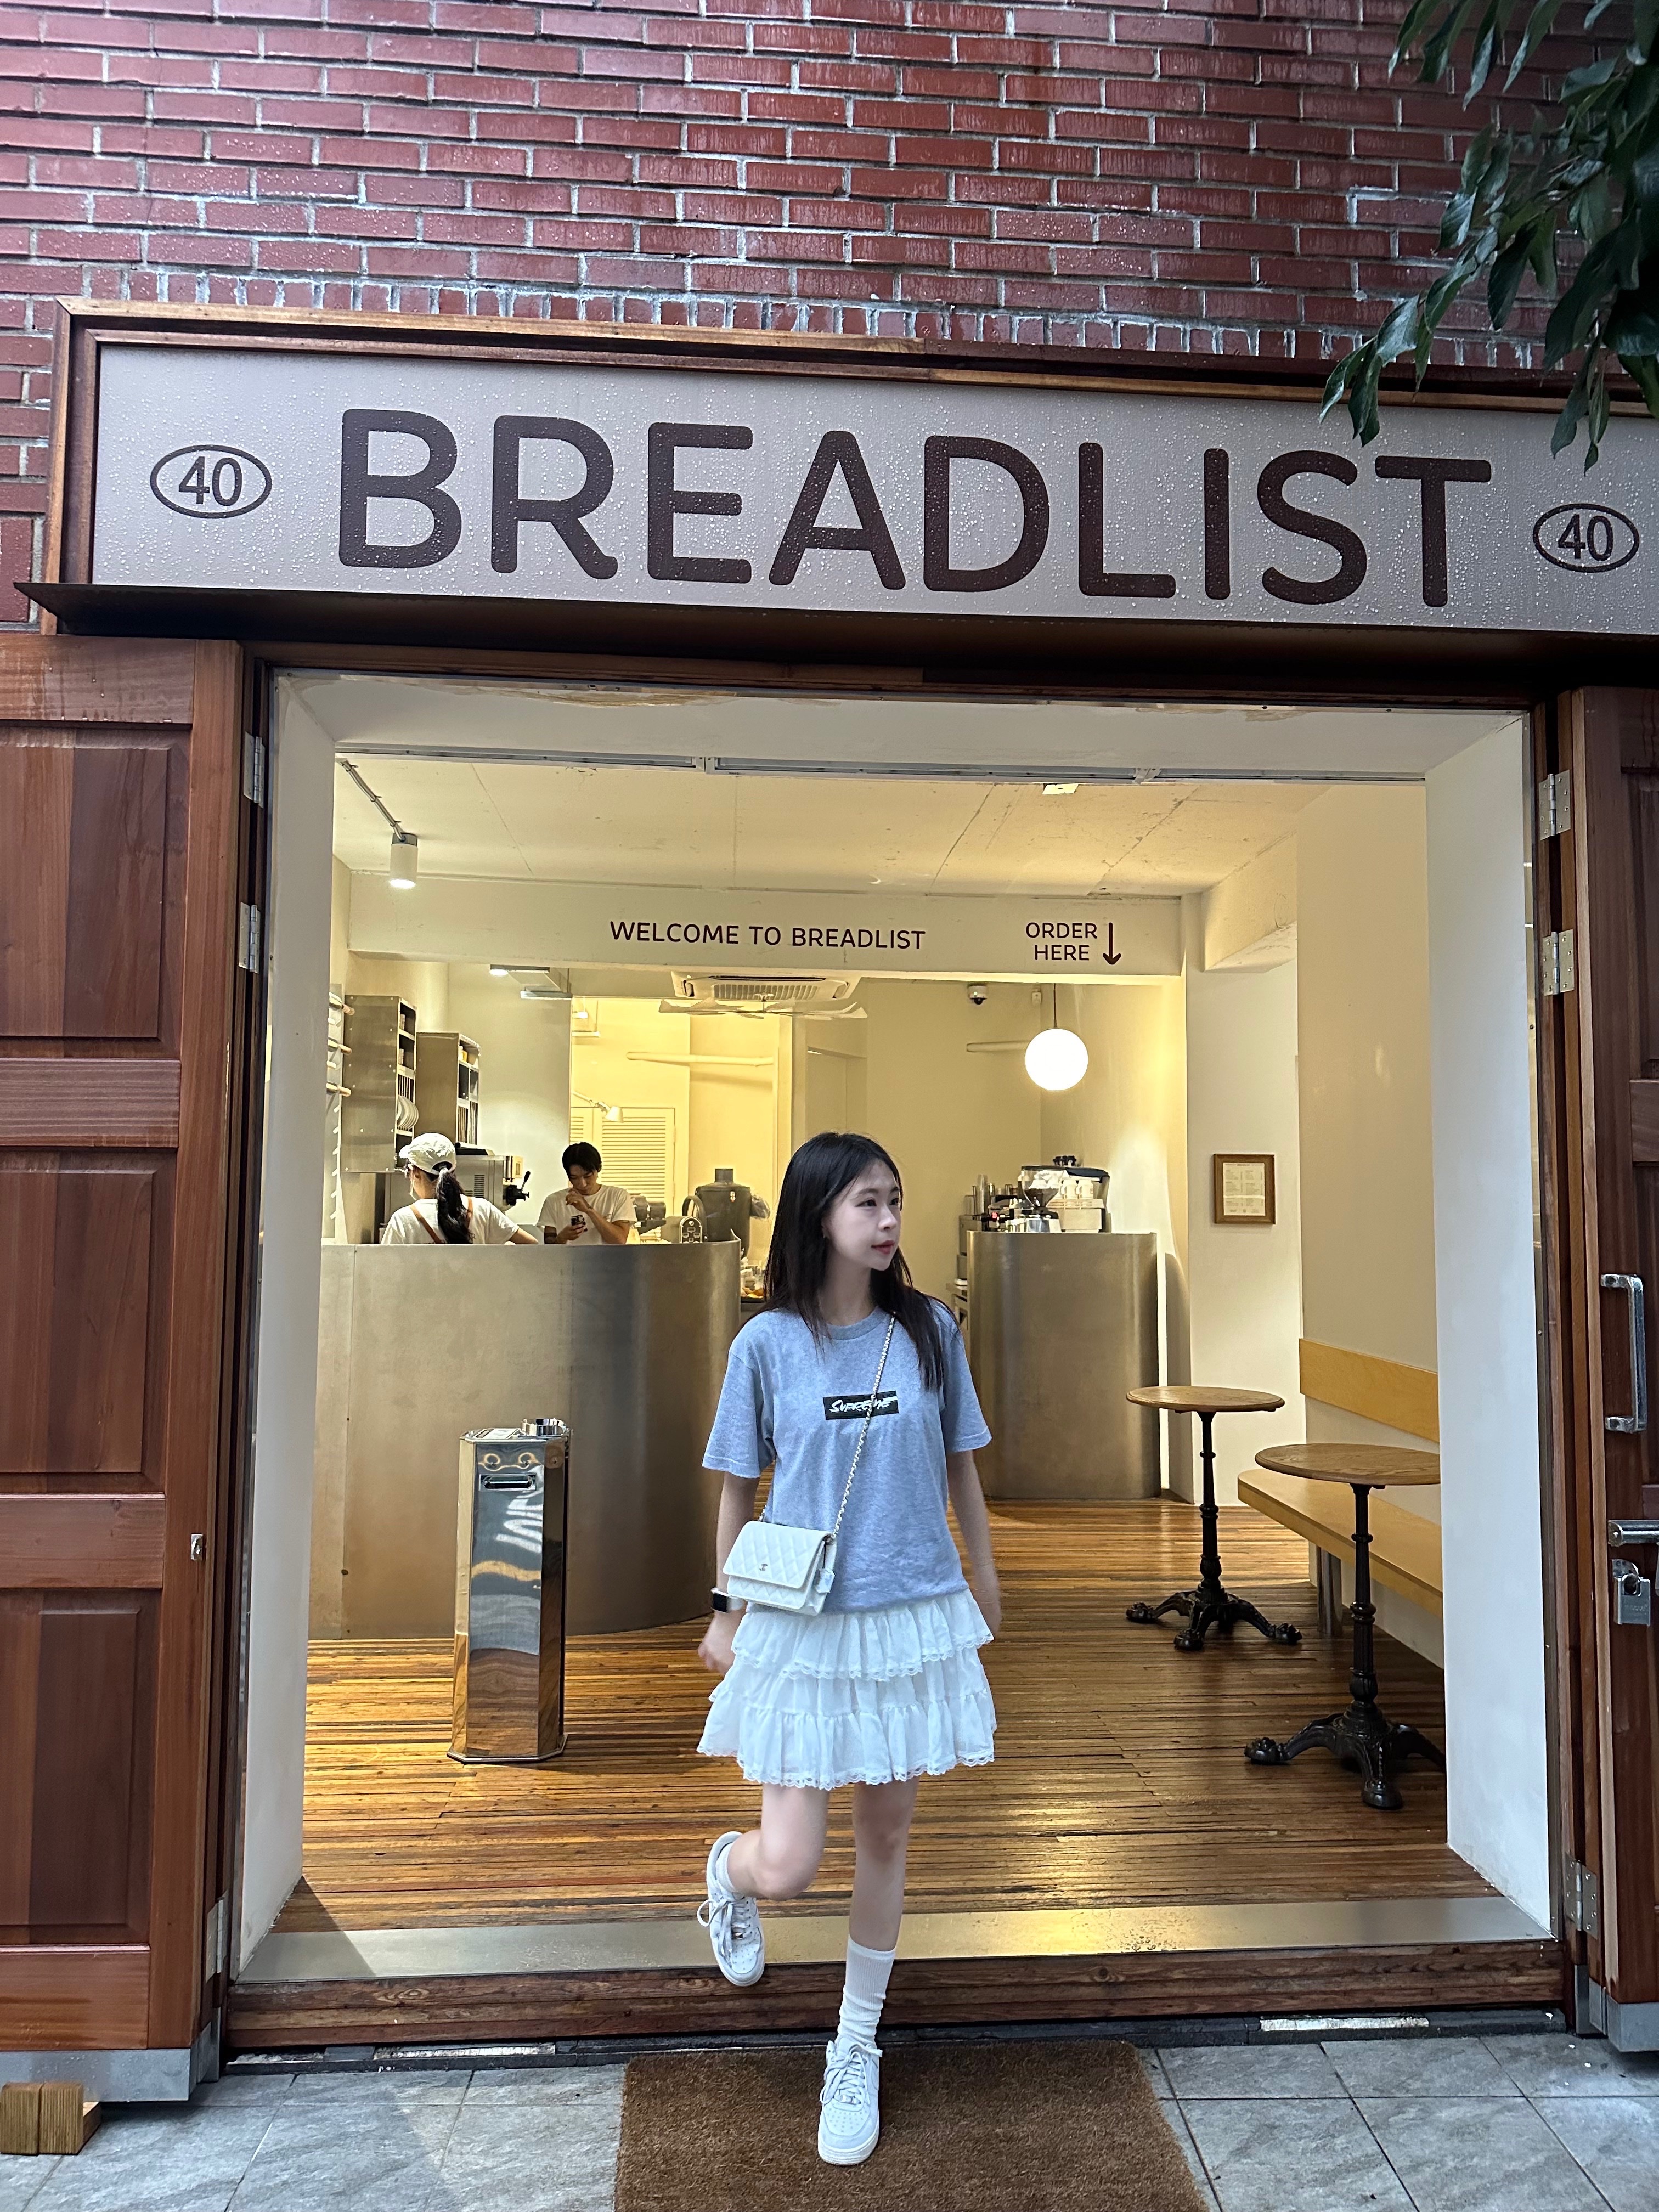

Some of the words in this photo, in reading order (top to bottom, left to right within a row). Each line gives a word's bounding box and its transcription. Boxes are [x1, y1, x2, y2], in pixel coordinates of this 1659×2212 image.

[178, 456, 242, 507] 40
[338, 409, 1492, 608] BREADLIST
[1558, 513, 1614, 561] 40
[610, 921, 739, 944] WELCOME
[748, 926, 781, 946] TO
[792, 928, 926, 950] BREADLIST
[1026, 922, 1098, 939] ORDER
[1035, 944, 1090, 961] HERE
